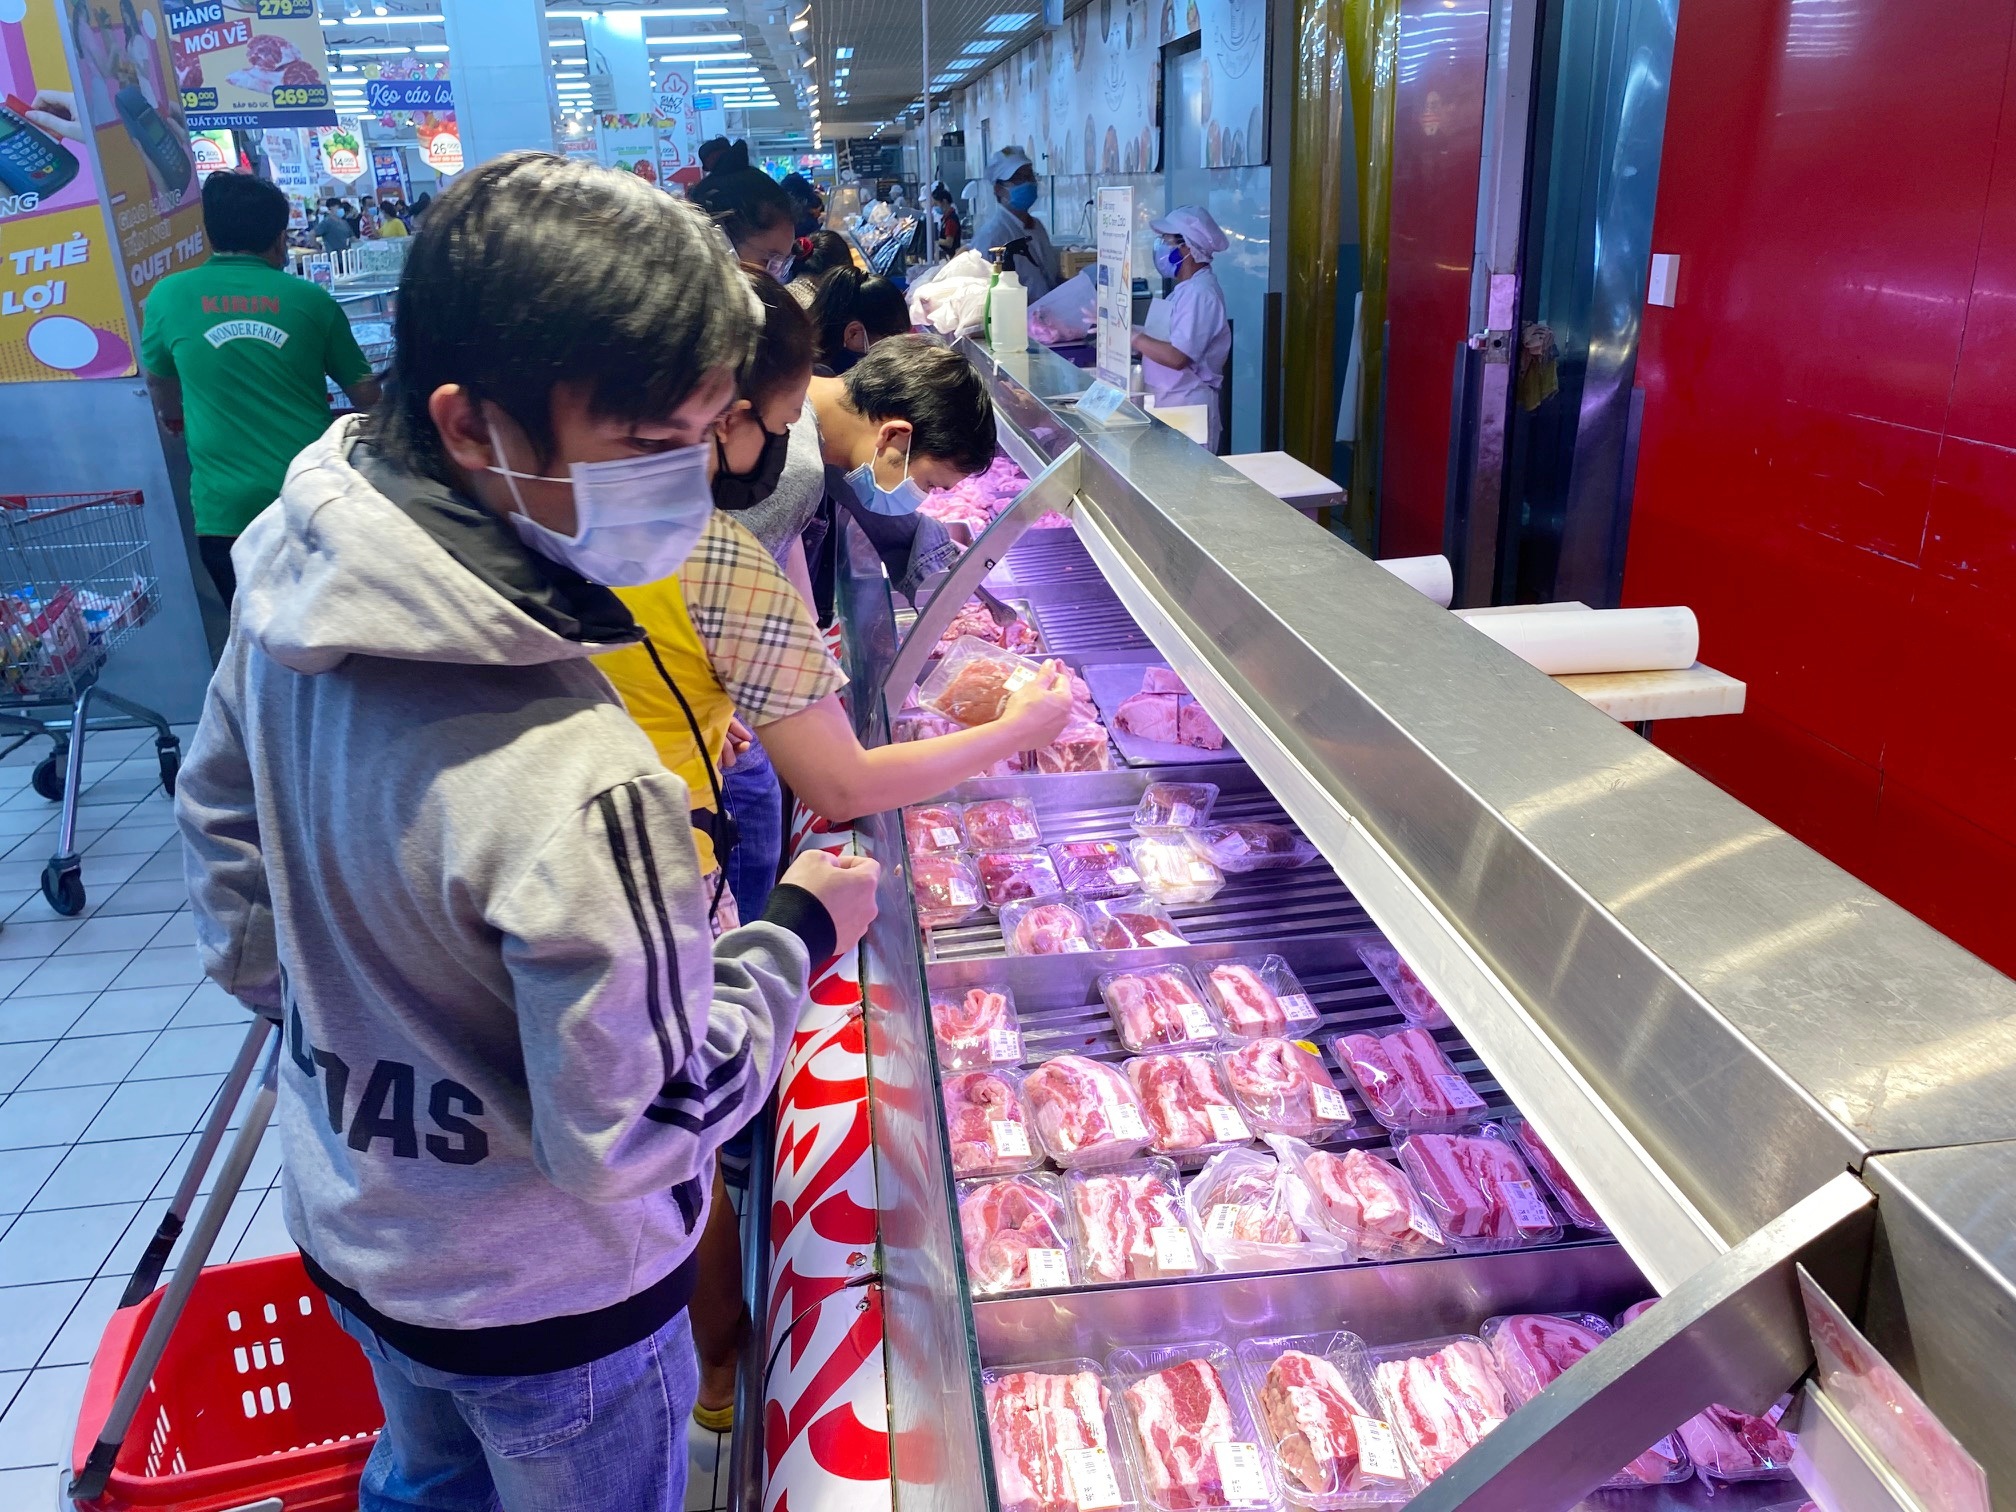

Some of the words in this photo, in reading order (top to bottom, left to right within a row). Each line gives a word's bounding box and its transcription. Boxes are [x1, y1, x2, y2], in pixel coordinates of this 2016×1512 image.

[172, 4, 222, 30] HÀNG
[259, 0, 293, 16] 279
[184, 29, 220, 55] MỚI
[222, 21, 248, 46] VỀ
[273, 88, 309, 106] 269
[370, 83, 401, 107] Kẹo
[405, 85, 431, 104] các
[433, 143, 447, 155] 26
[9, 231, 89, 275] THẺ
[1, 280, 66, 315] LỢI
[202, 296, 280, 314] KIRIN
[208, 322, 283, 345] WONDERFARM
